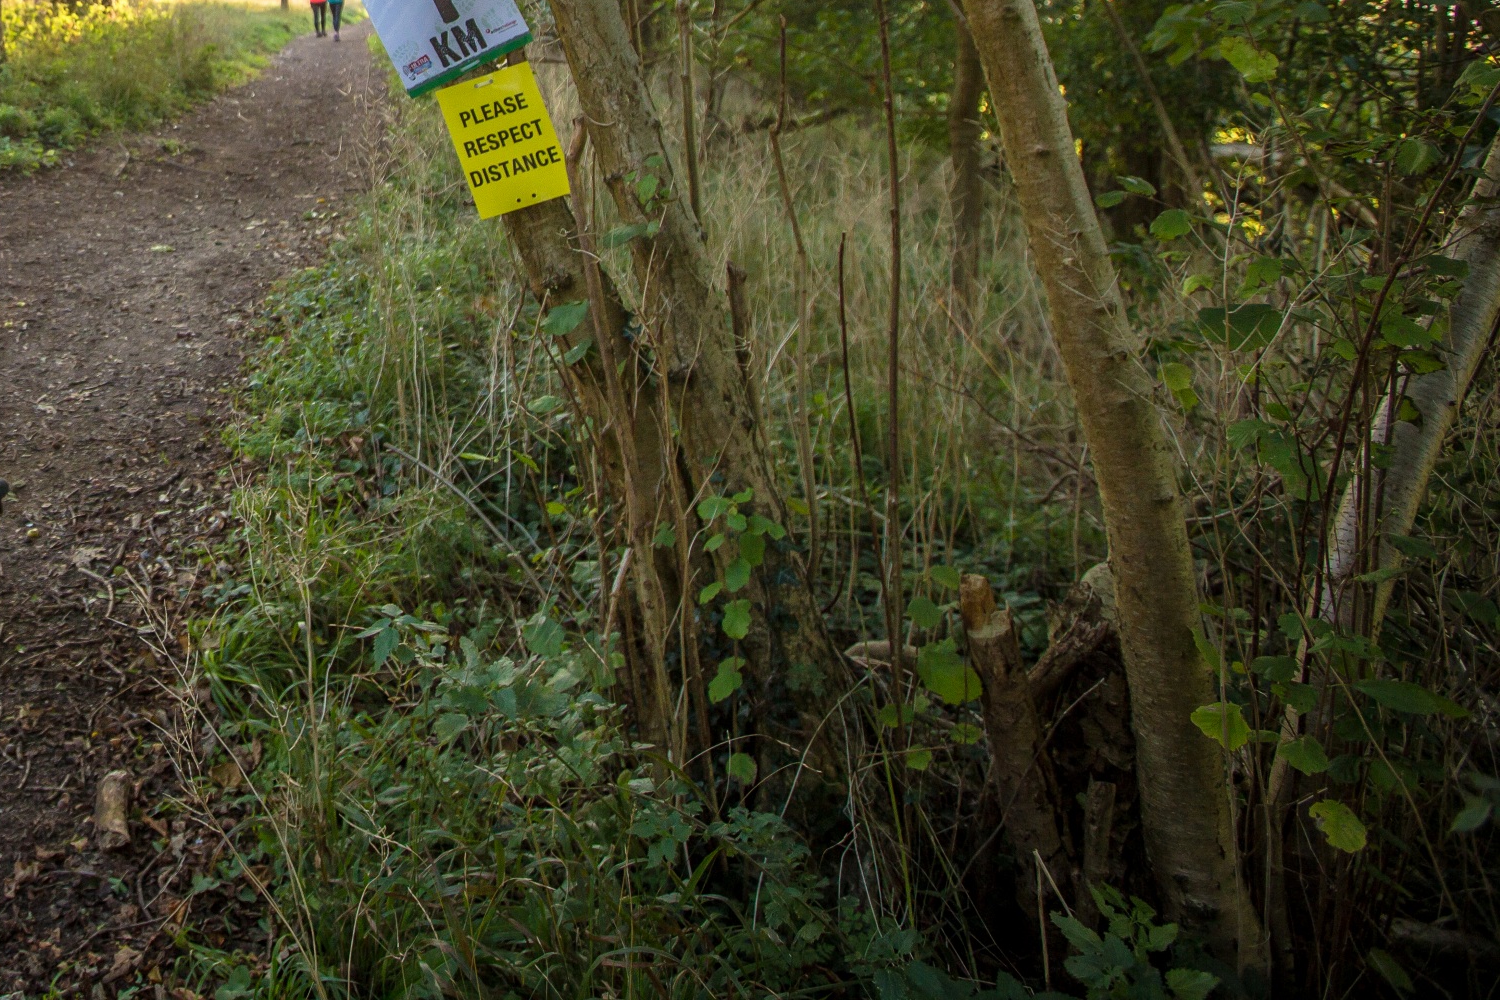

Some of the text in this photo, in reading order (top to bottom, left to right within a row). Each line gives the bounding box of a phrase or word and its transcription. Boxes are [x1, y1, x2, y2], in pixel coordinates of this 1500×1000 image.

[429, 17, 488, 68] KM
[459, 92, 529, 128] PLEASE
[463, 118, 543, 159] RESPECT
[469, 145, 562, 188] DISTANCE
